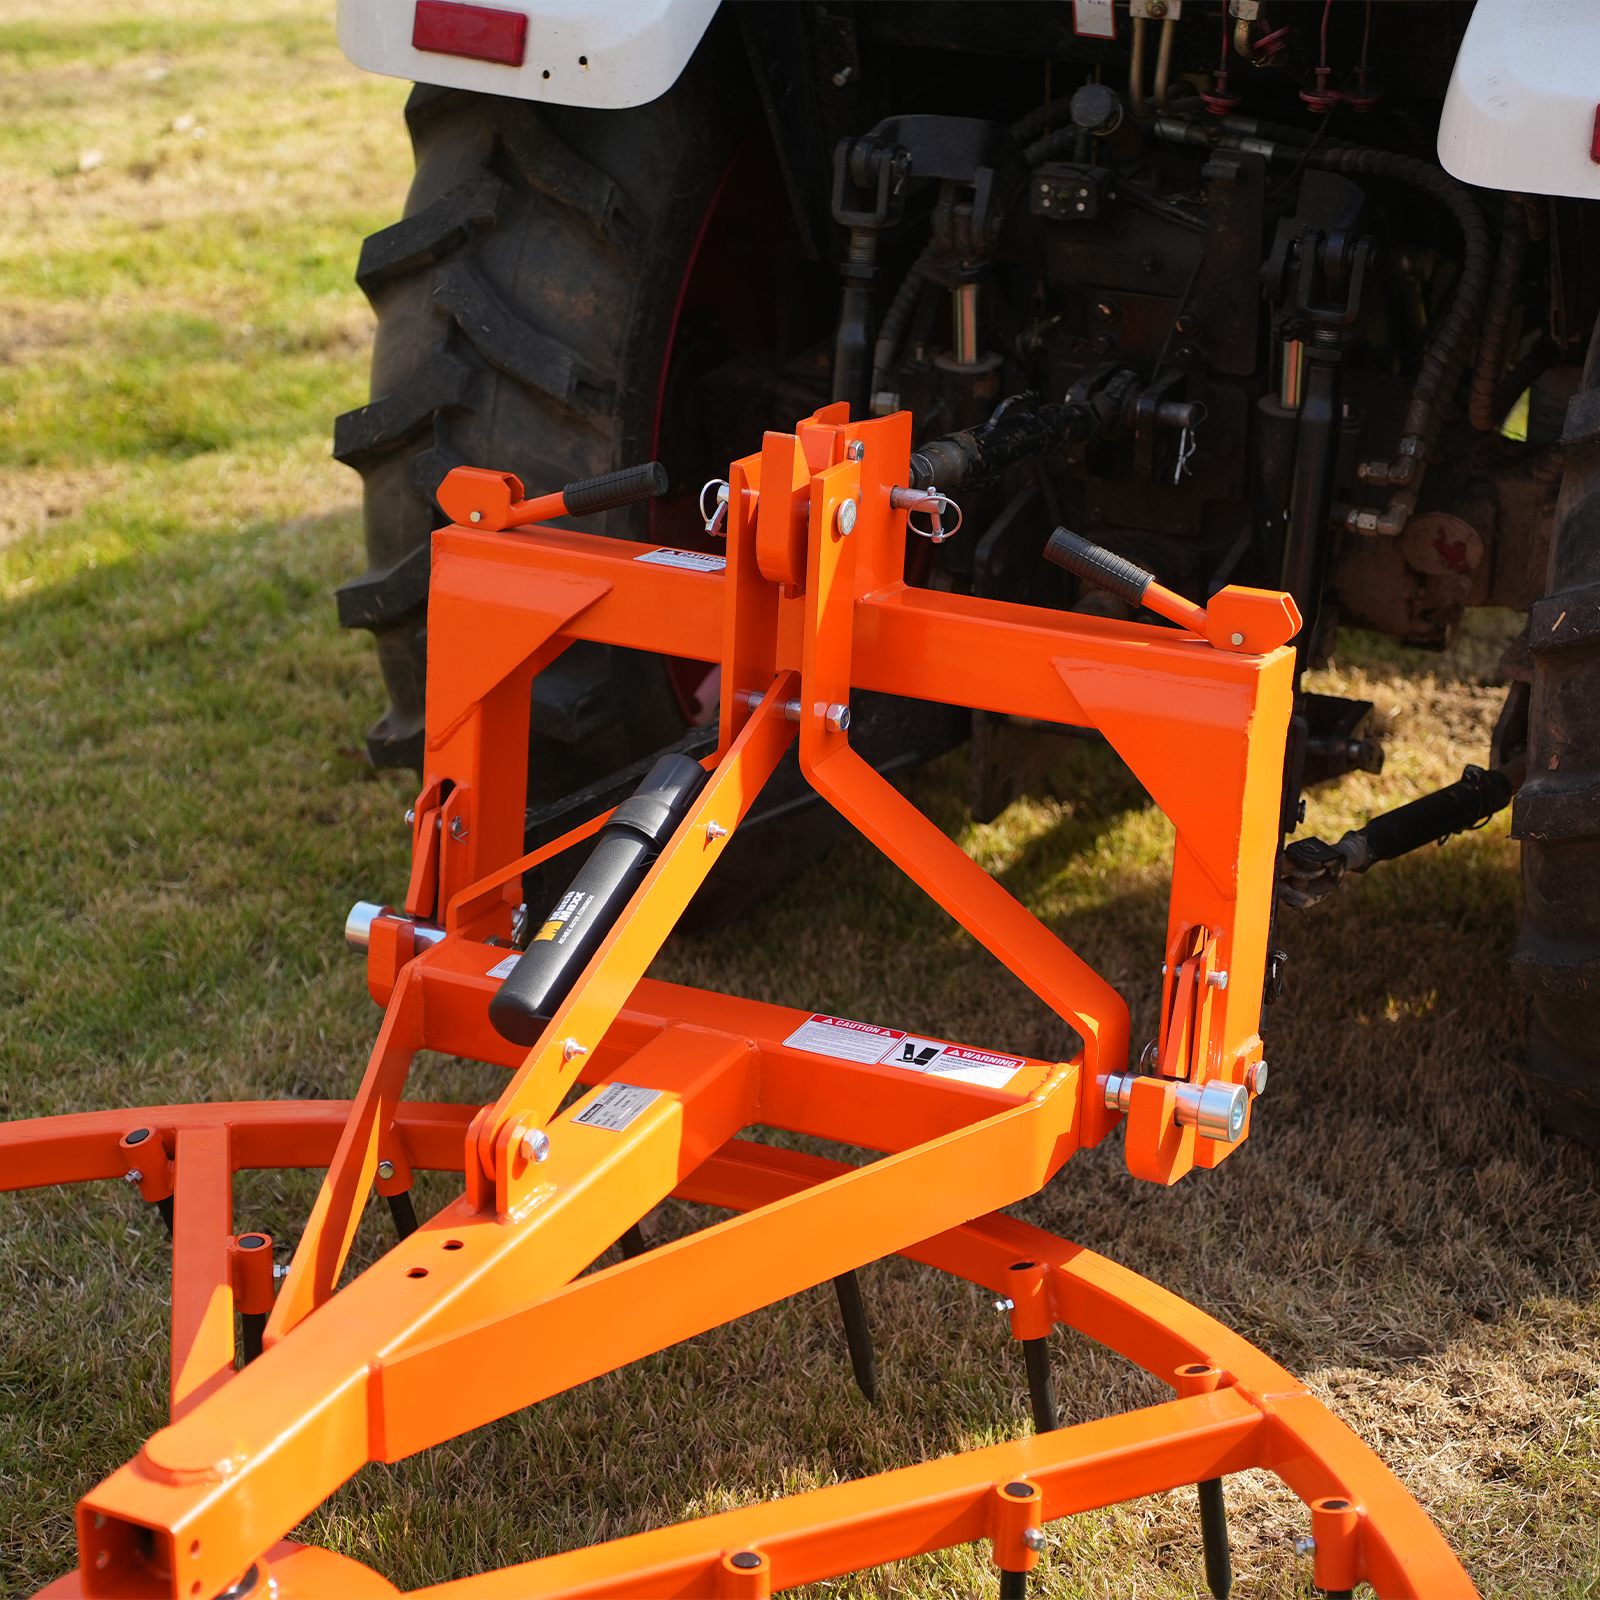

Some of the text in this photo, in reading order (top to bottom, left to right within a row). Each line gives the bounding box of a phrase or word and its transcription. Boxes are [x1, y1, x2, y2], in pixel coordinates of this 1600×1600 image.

[557, 891, 586, 922] Maxx
[835, 1017, 881, 1034] CAUTION
[961, 1050, 1018, 1068] WARNING
